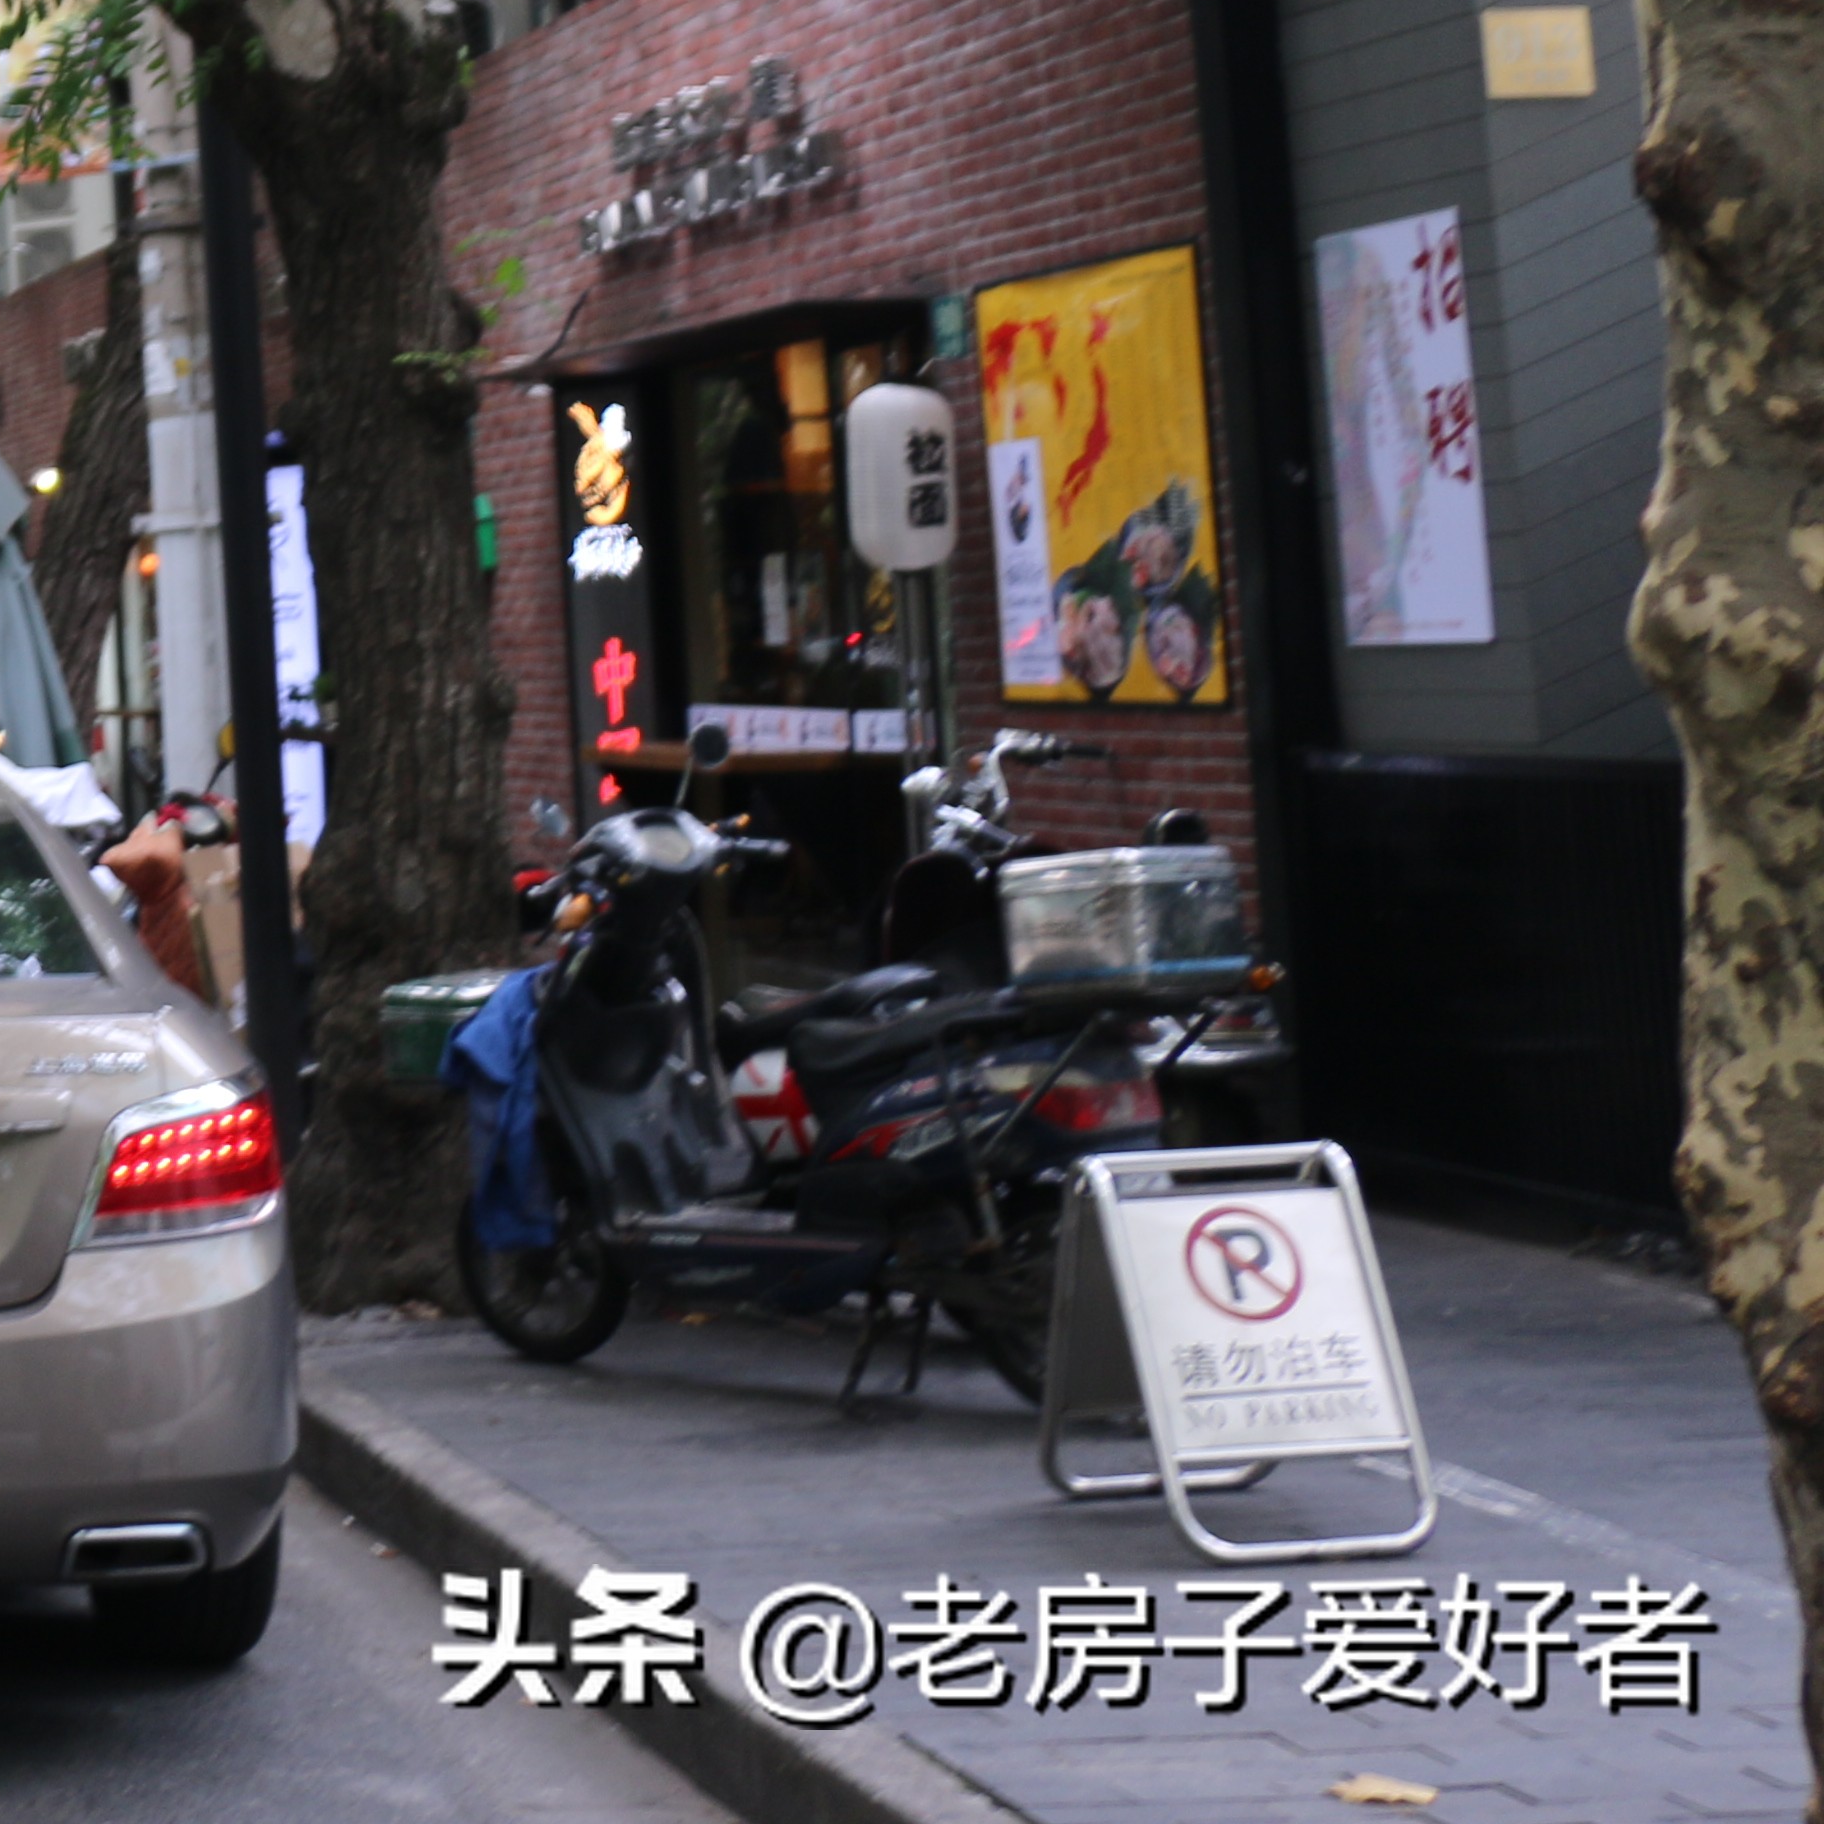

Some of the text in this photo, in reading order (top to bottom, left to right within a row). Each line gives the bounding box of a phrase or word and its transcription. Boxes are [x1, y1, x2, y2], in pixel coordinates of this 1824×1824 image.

[1412, 218, 1474, 486] 招聘
[1171, 1331, 1368, 1388] 请勿泊车
